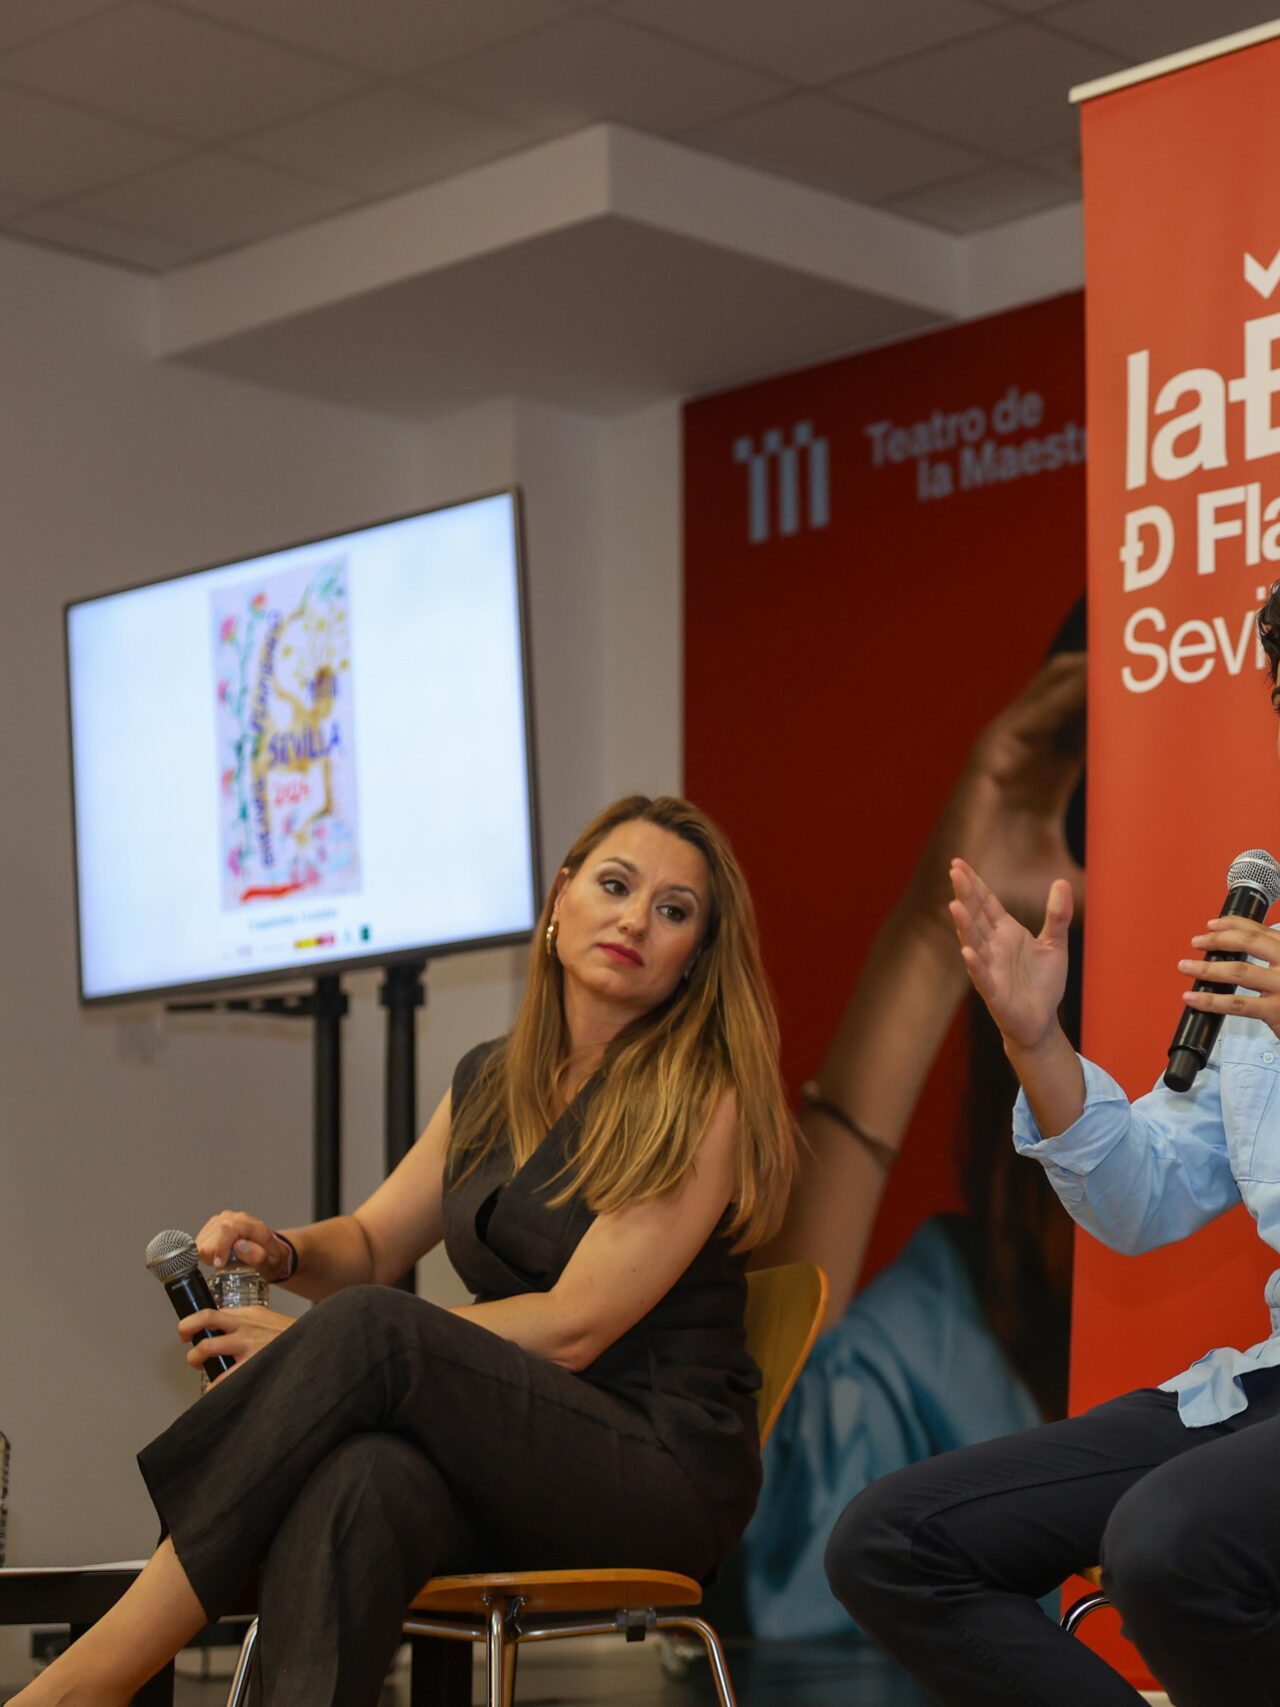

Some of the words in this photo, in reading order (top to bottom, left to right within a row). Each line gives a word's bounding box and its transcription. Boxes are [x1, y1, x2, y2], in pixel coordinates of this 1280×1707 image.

[866, 406, 986, 467] Teatro
[992, 385, 1044, 434] de
[917, 459, 955, 502] la
